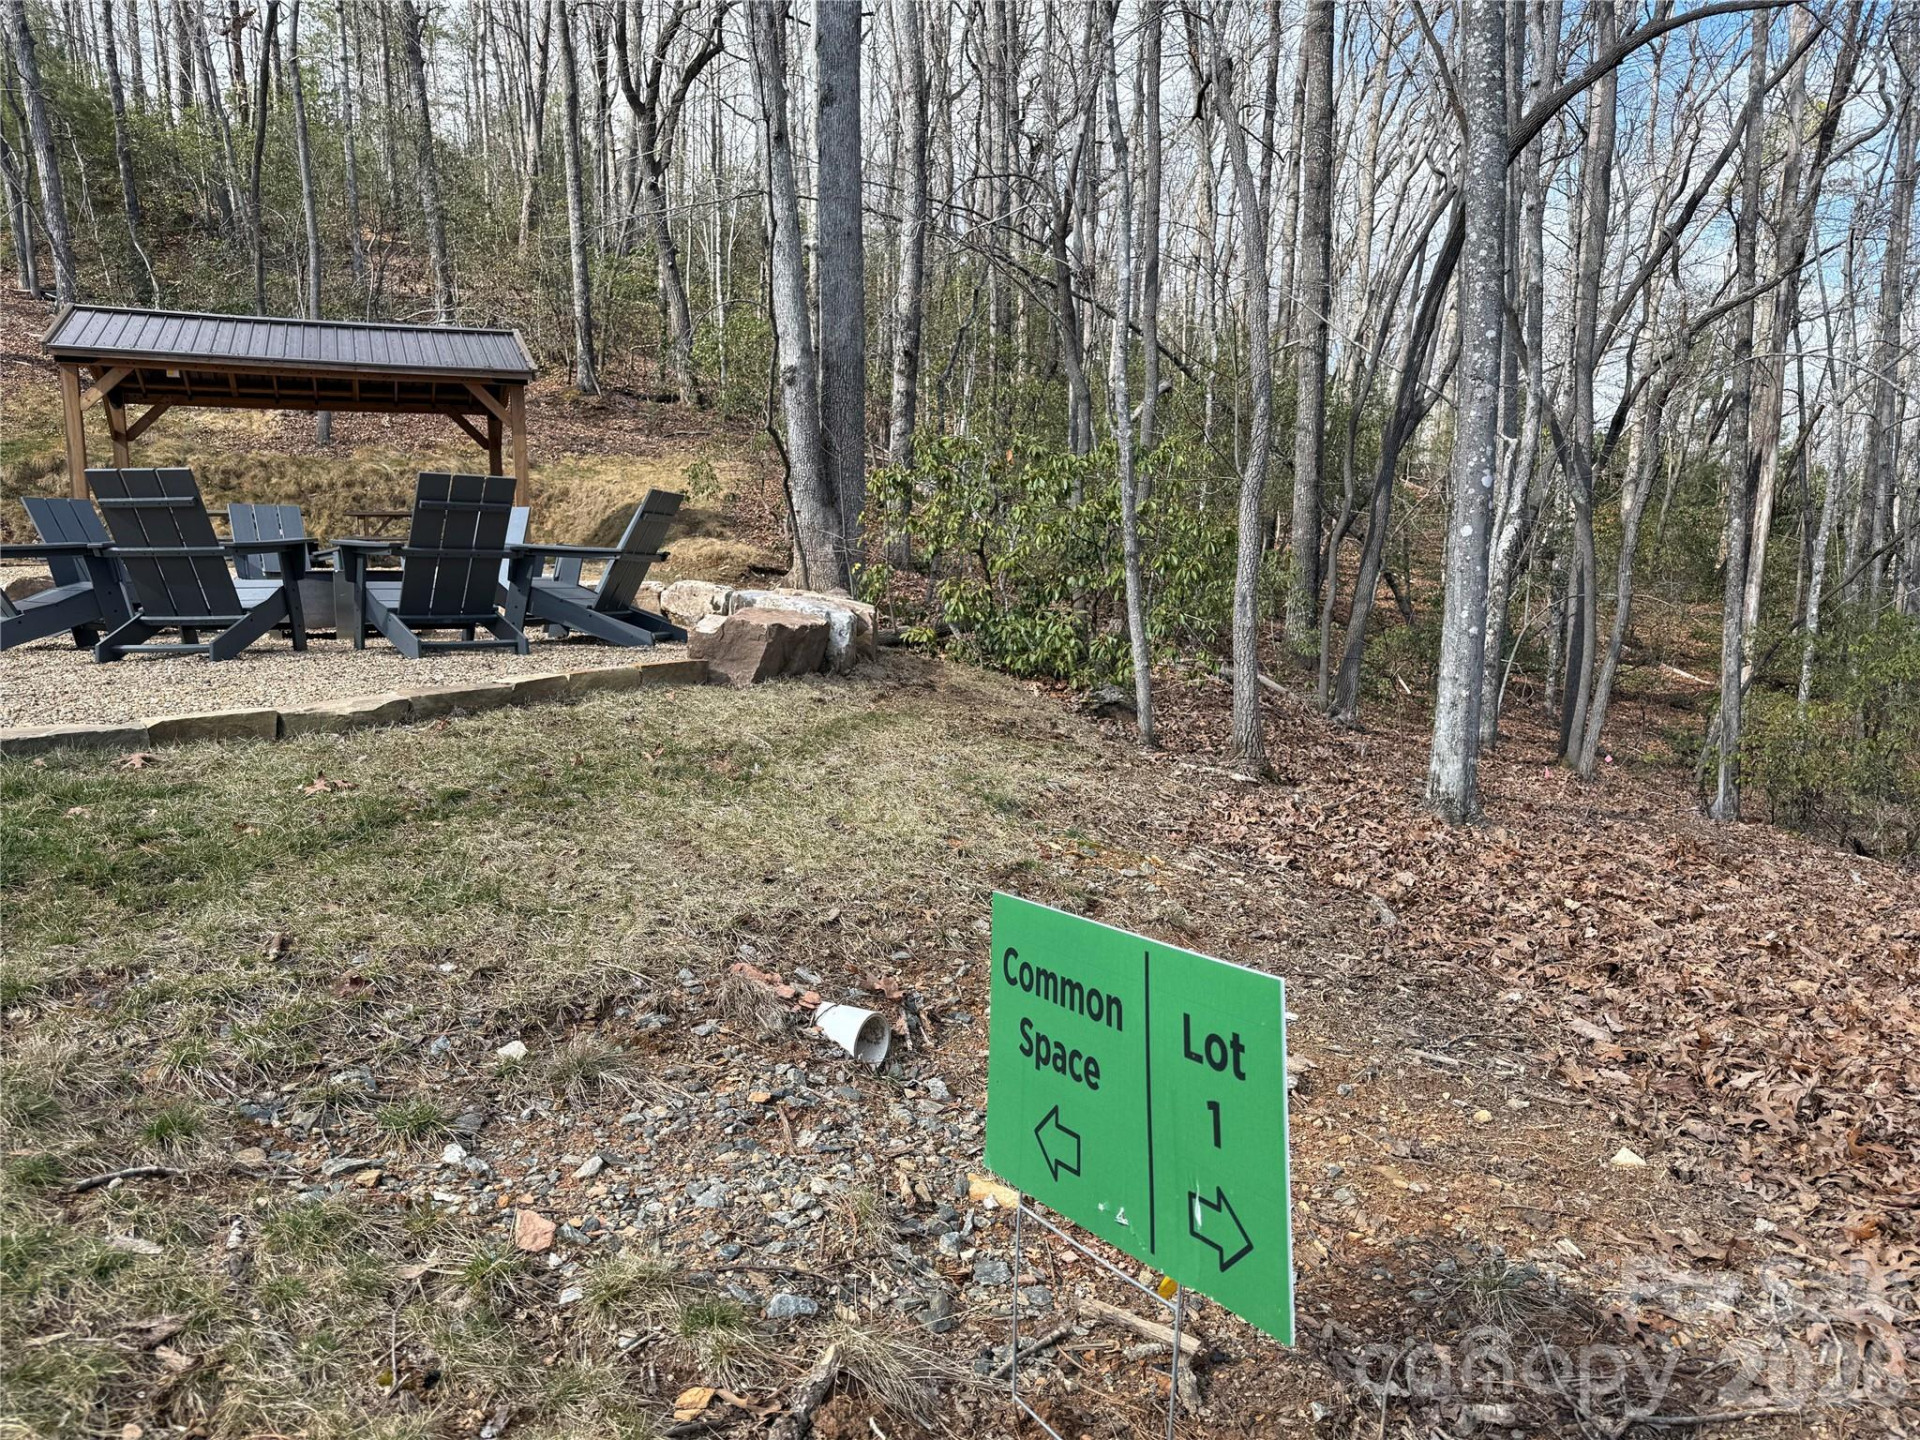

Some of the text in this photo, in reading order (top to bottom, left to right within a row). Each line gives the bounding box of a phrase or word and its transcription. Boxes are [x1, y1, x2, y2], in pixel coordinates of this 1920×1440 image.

[1002, 946, 1123, 1032] Common
[1019, 1016, 1102, 1091] Space
[1182, 1012, 1247, 1081] Lot
[1206, 1099, 1222, 1149] 1
